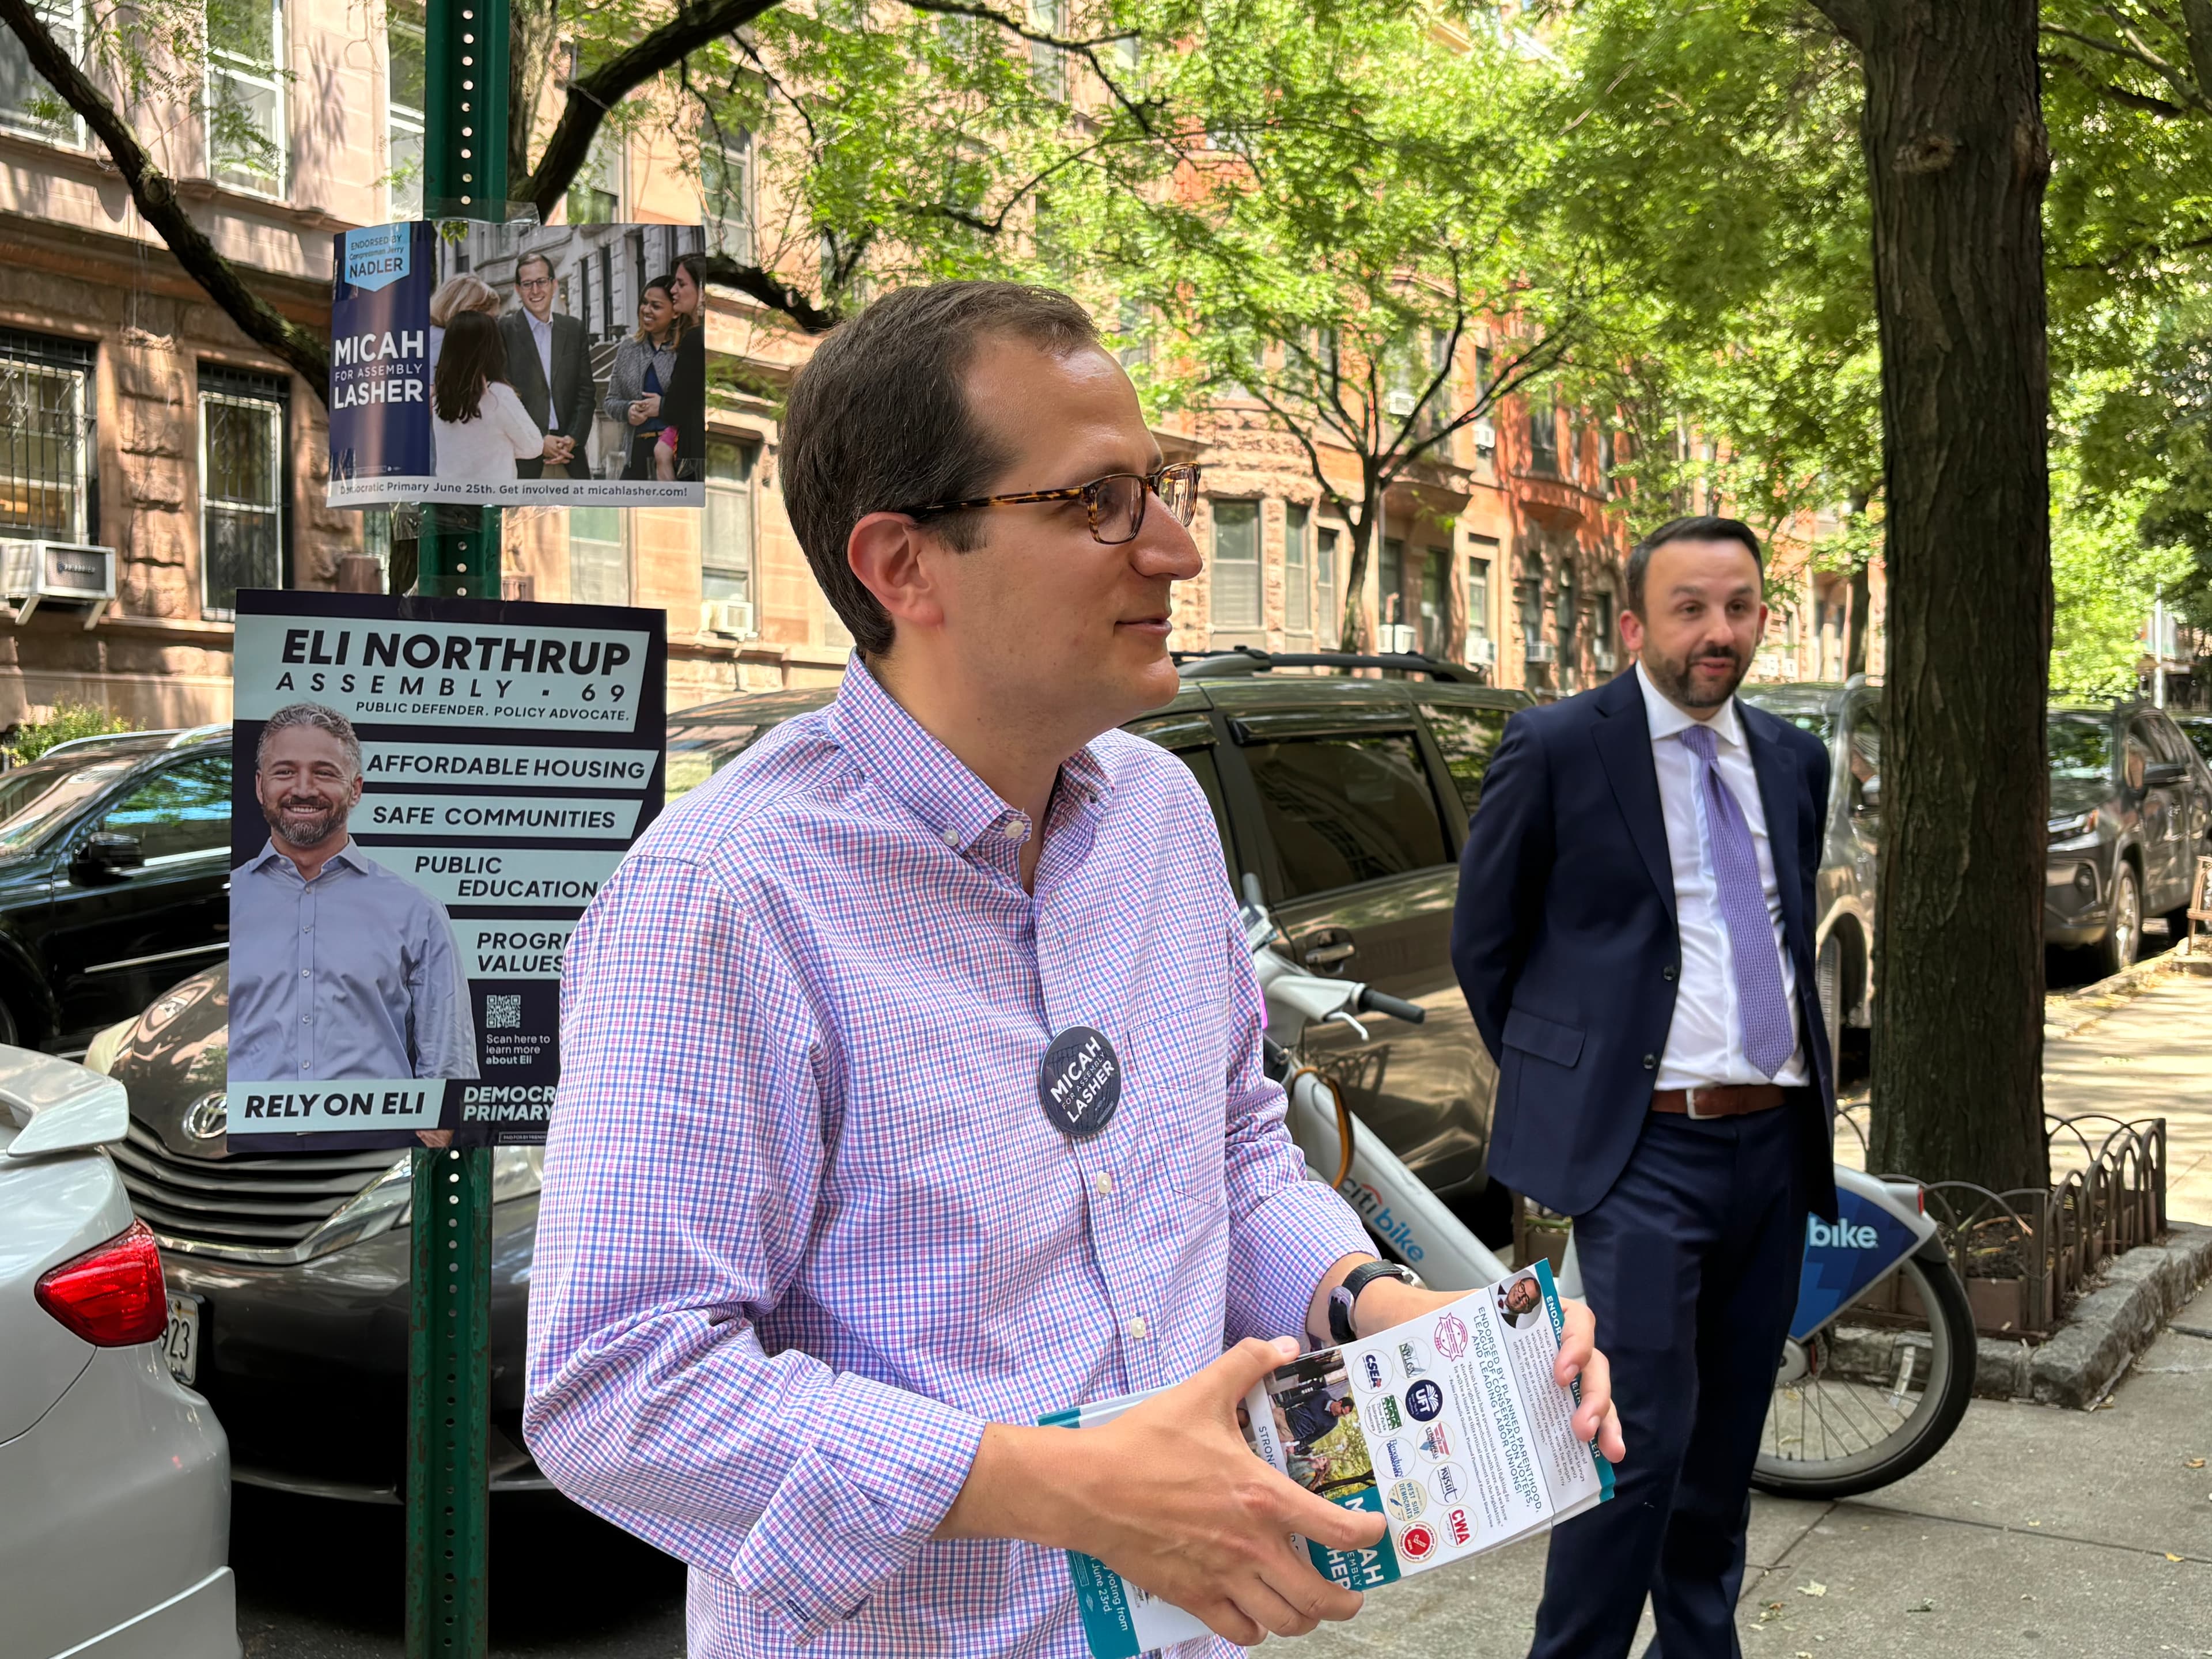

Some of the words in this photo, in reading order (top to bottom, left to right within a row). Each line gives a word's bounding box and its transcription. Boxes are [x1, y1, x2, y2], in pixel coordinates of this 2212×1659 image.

[349, 249, 386, 260] Congressman
[387, 246, 404, 254] Jerry
[351, 237, 389, 251] ENDORSED
[392, 235, 402, 243] BY
[350, 257, 403, 278] NADLER
[335, 330, 423, 367] MICAH
[335, 369, 353, 382] FOR
[357, 363, 422, 378] ASSEMBLY
[334, 379, 423, 410] LASHER
[387, 482, 429, 493] Primary
[434, 483, 461, 493] June
[465, 484, 495, 494] 25th.
[499, 485, 518, 494] Get
[522, 485, 569, 494] involved
[573, 486, 584, 495] at
[588, 486, 688, 497] micahlasher.com!
[282, 628, 350, 665] ELI
[363, 632, 630, 676] NORTHRUP
[276, 672, 513, 698] ASSEMBLY
[581, 684, 625, 702] 69
[356, 701, 408, 714] PUBLIC
[412, 703, 488, 716] DEFENDER.
[494, 706, 546, 718] POLICY
[550, 708, 630, 721] ADVOCATE.
[366, 754, 528, 777] AFFORDABLE
[533, 759, 645, 779] HOUSING
[373, 806, 434, 824] SAFE
[445, 808, 615, 828] COMMUNITIES
[415, 856, 502, 874] PUBLIC
[457, 879, 598, 897] EDUCATION
[478, 955, 563, 972] VALUES
[486, 1034, 512, 1044] Scan
[514, 1035, 537, 1044] here
[540, 1035, 551, 1044] to
[486, 1045, 511, 1054] learn
[514, 1046, 540, 1054] more
[486, 1055, 518, 1065] about
[520, 1055, 532, 1065] Eli
[1050, 1036, 1101, 1103] MICAH
[1061, 1092, 1075, 1110] FOR
[1077, 1052, 1105, 1092] ASSEMBLY
[1067, 1060, 1115, 1123] LASHER
[245, 1093, 321, 1118] RELY
[324, 1093, 374, 1116] ON
[382, 1092, 425, 1114] ELI
[463, 1104, 554, 1122] PRIMARY
[1374, 1207, 1425, 1263] bike
[1809, 1217, 1878, 1249] bike
[1364, 1353, 1383, 1388] CSEA
[1414, 1389, 1431, 1414] UFT
[1471, 1335, 1483, 1358] AND
[1479, 1361, 1498, 1408] LEADING
[1493, 1411, 1510, 1448] LABOR
[1504, 1449, 1523, 1494] UNIONS!
[1472, 1315, 1491, 1358] LEAGUE
[1486, 1360, 1496, 1375] OF
[1491, 1378, 1521, 1460] CONSERVATION
[1514, 1461, 1535, 1508] VOTERS,
[1477, 1306, 1501, 1365] ENDORSED
[1495, 1367, 1505, 1381] BY
[1500, 1384, 1521, 1434] PLANNED
[1515, 1437, 1544, 1513] PARENTHOOD,
[1397, 1483, 1414, 1520] DEMOCRATS
[1405, 1482, 1416, 1500] WEST
[1410, 1501, 1420, 1516] SIDE
[1342, 1496, 1386, 1585] MAH
[1449, 1508, 1472, 1545] CWA
[1346, 1551, 1363, 1587] EMBLY
[1091, 1562, 1104, 1587] June
[1098, 1588, 1112, 1615] 23rd.
[1105, 1573, 1122, 1605] voting
[1116, 1606, 1130, 1631] from
